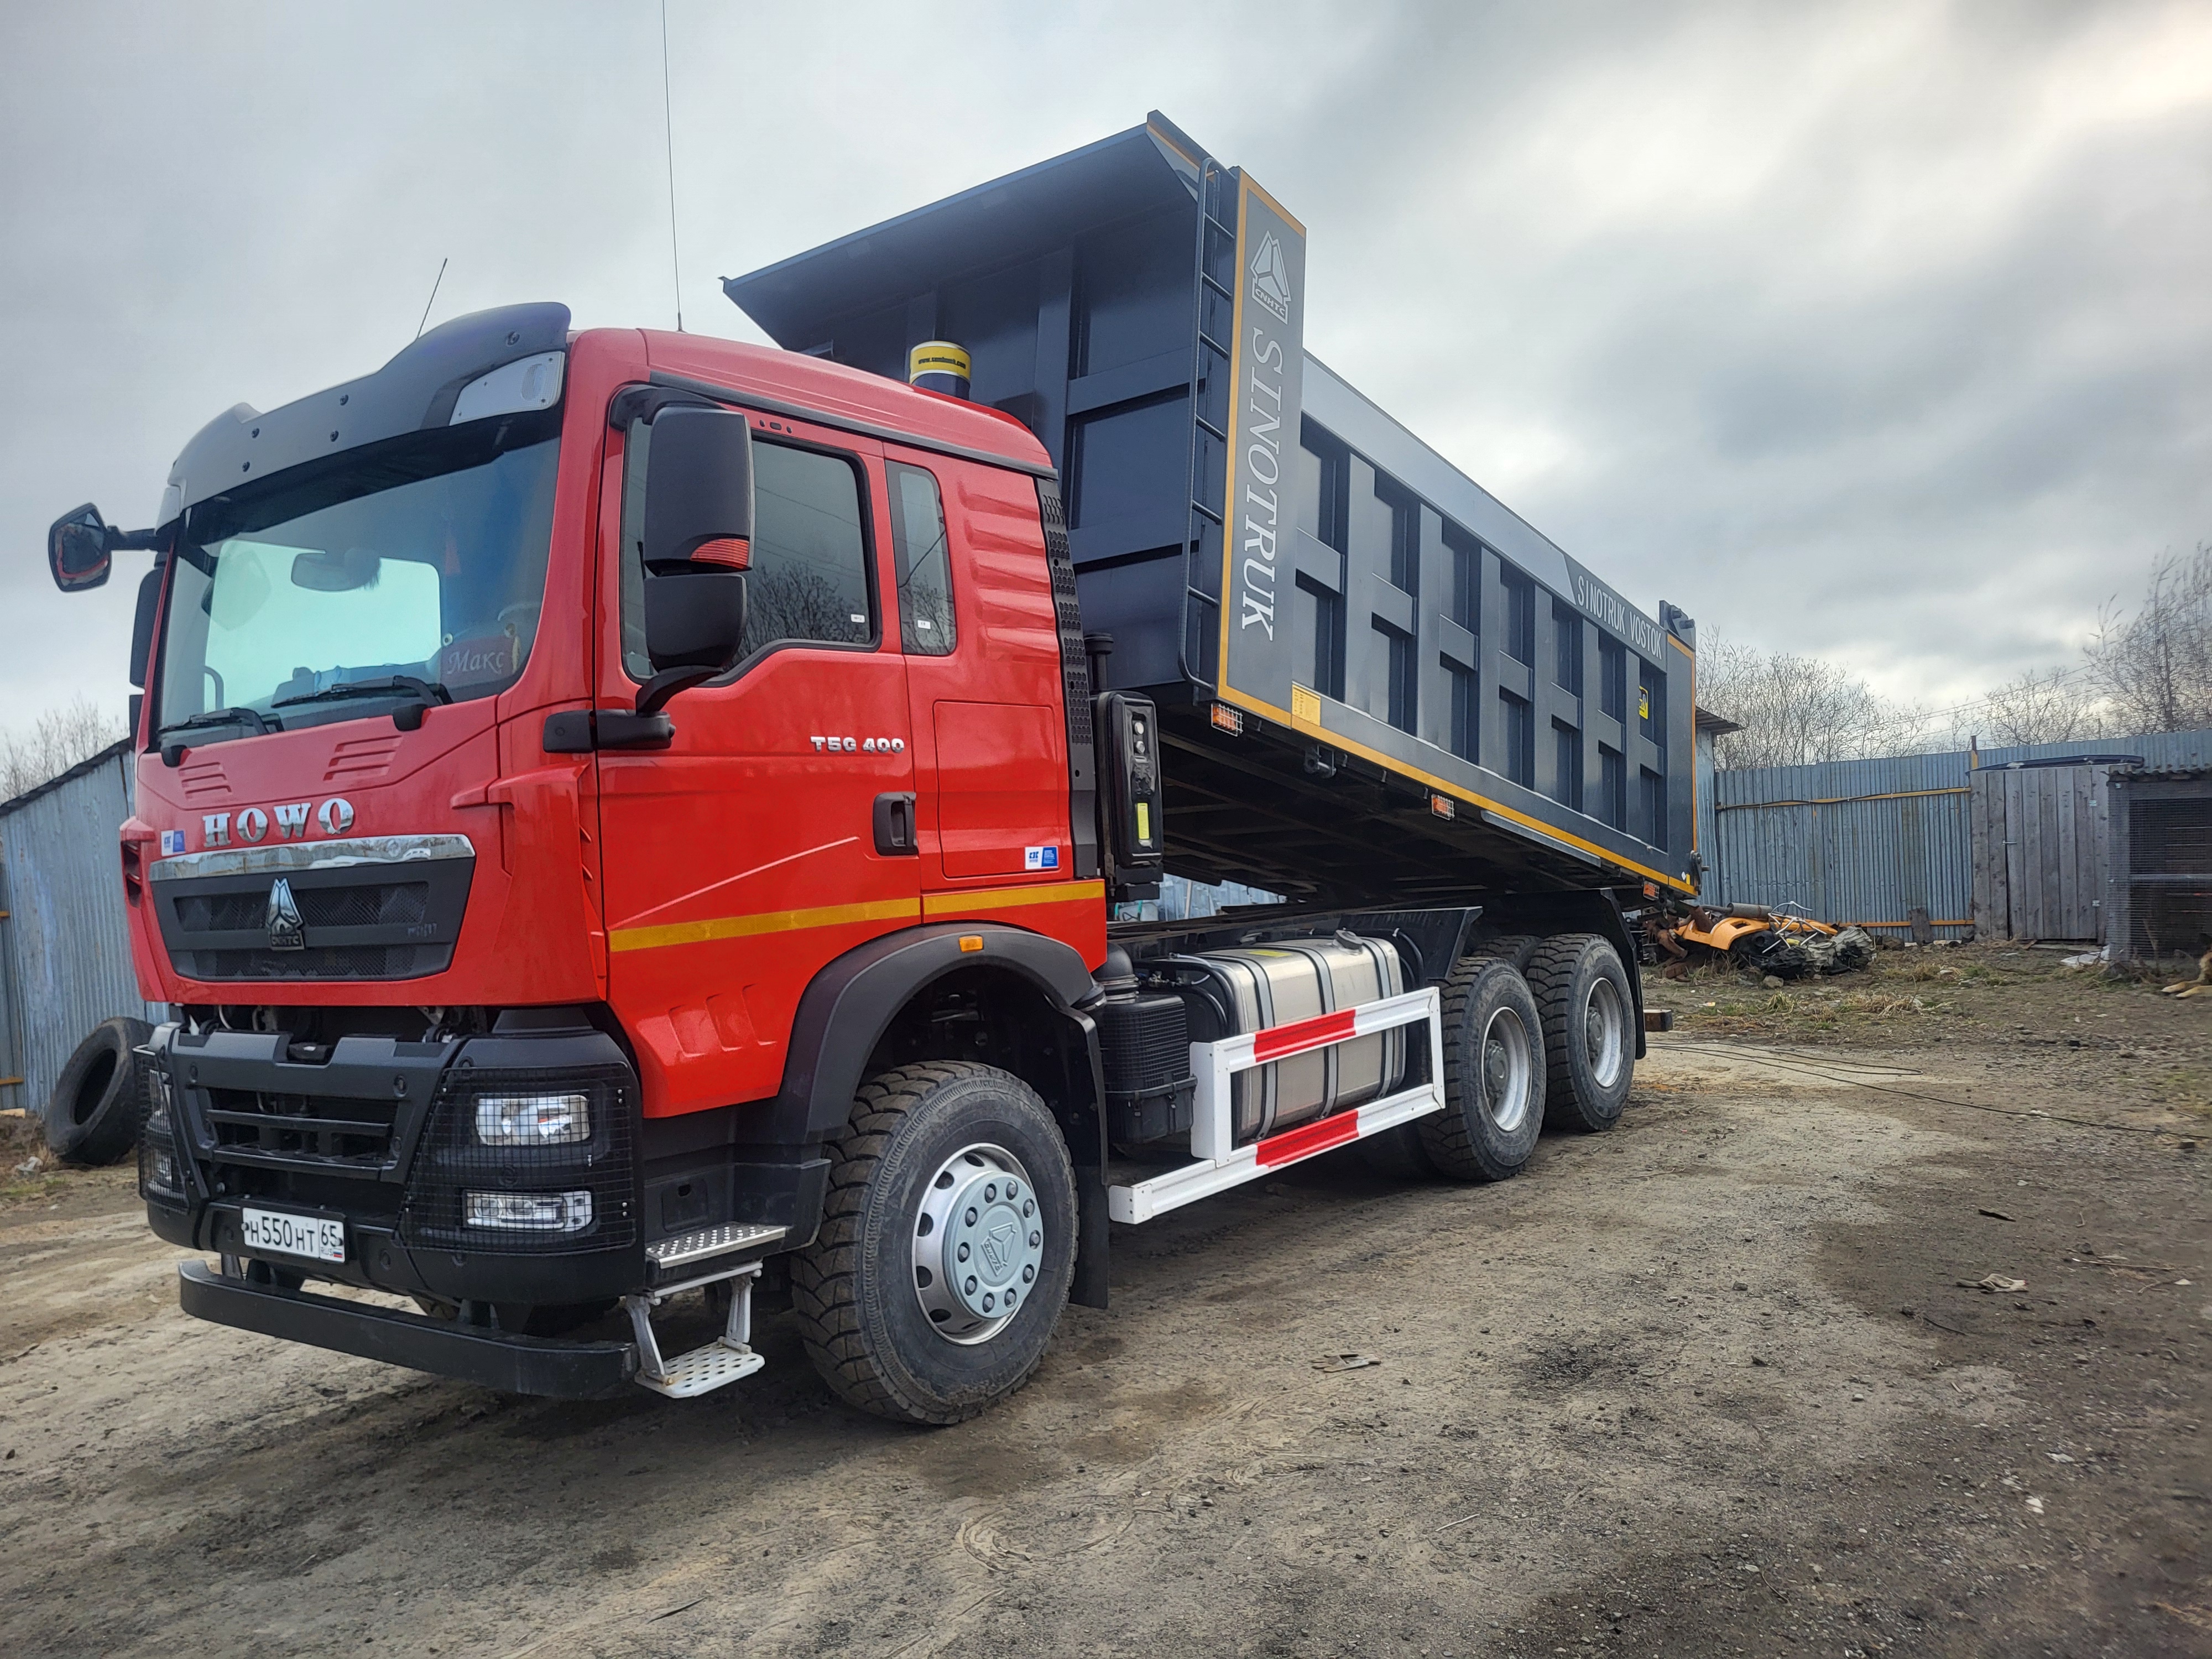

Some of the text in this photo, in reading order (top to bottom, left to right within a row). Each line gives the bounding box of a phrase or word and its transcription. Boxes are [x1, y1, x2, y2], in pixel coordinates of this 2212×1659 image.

[1255, 288, 1286, 316] CNHTC
[1241, 327, 1285, 642] SINOTRUK
[1577, 575, 1663, 660] SINOTRUK VOSTOK
[446, 649, 505, 675] Макс
[810, 736, 905, 753] T5G 400
[202, 797, 354, 848] HOWO
